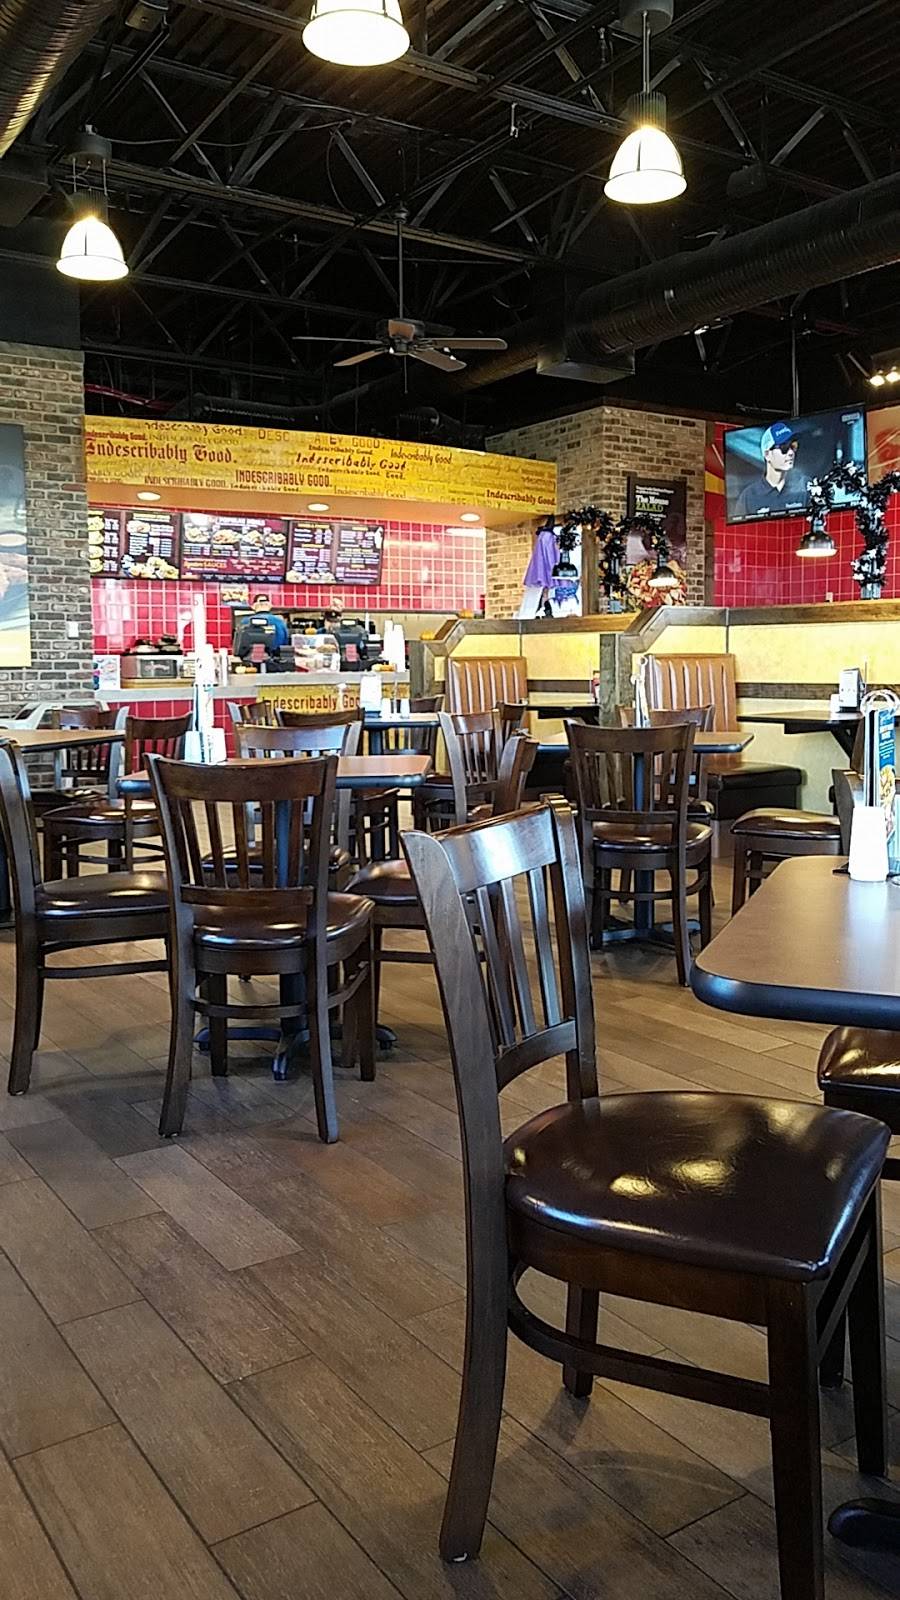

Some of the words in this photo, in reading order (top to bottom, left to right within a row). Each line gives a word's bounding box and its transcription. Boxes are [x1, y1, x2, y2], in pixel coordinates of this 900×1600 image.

[86, 438, 187, 463] Indescribably
[296, 452, 376, 470] Indescribably
[235, 469, 304, 486] INDESCRIBABLY
[307, 473, 333, 488] GOOD.
[487, 489, 536, 505] Indescribably
[635, 494, 649, 504] The
[262, 695, 337, 710] describably
